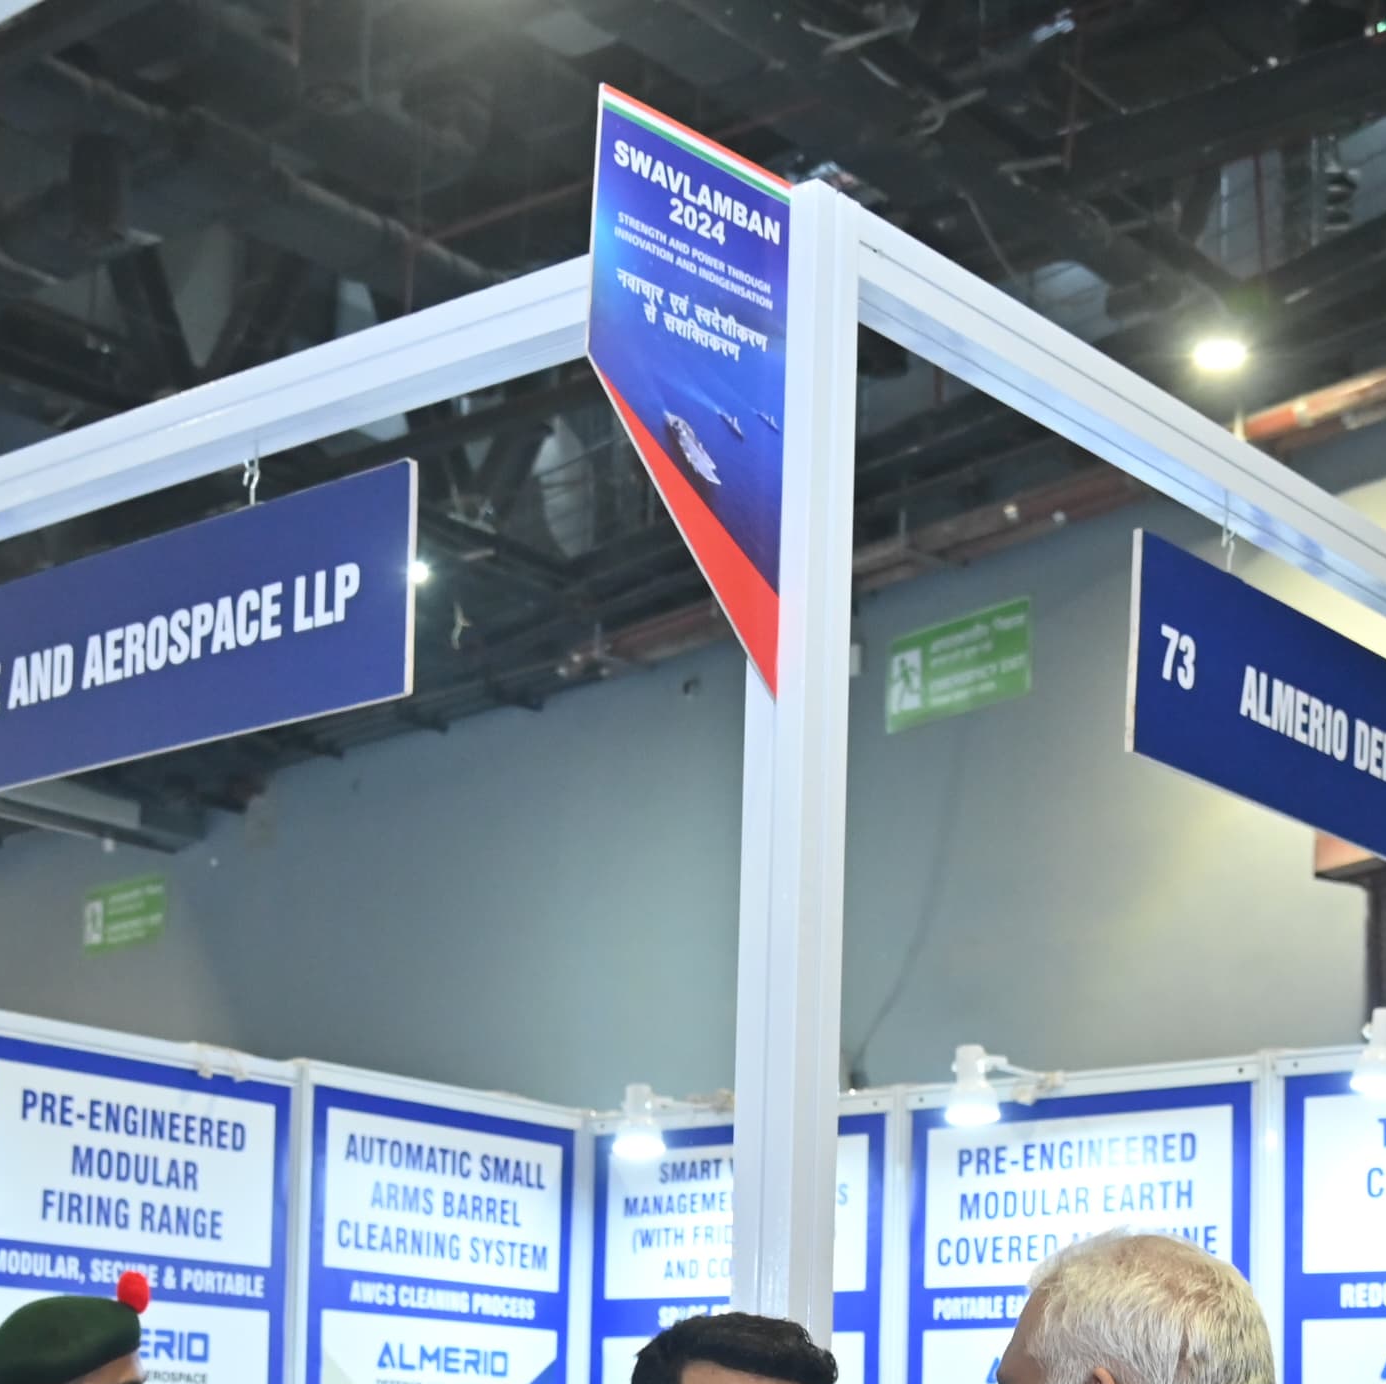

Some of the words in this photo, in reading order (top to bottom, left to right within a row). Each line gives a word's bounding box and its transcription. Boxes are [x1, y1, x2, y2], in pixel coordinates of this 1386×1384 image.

[614, 140, 781, 244] SWAVLAMBAN
[669, 198, 725, 245] 2024
[615, 226, 674, 263] INNOVATION
[676, 256, 697, 274] AND
[699, 268, 773, 310] INDIGENISATION
[618, 212, 667, 244] STRENGTH
[669, 237, 690, 255] AND
[692, 247, 725, 274] POWER
[727, 264, 771, 294] THROUGH
[8, 643, 73, 708] AND
[82, 582, 282, 688] AEROSPACE
[293, 562, 361, 632] LLP
[1161, 624, 1196, 690] 73
[1239, 665, 1347, 762] ALMERIO
[22, 1088, 246, 1151] PRE-ENGINEERED
[71, 1145, 198, 1191] MODULAR
[345, 1133, 472, 1180] AUTOMATIC
[481, 1154, 545, 1190] SMALL
[659, 1158, 721, 1184] SMART
[958, 1132, 1197, 1178] PRE-ENGINEERED
[42, 1189, 129, 1230] FIRING
[141, 1202, 223, 1240] RANGE
[371, 1180, 434, 1216] ARMS
[443, 1191, 521, 1227] BARREL
[623, 1192, 733, 1218] MANAGEME
[960, 1186, 1089, 1221] MODULAR
[1103, 1180, 1193, 1212] EARTH
[337, 1220, 460, 1261] CLEARNING
[469, 1236, 547, 1272] SYSTEM
[633, 1228, 684, 1254] (WITH
[937, 1234, 1058, 1267] COVERED
[163, 1265, 176, 1290] &
[181, 1268, 265, 1298] PORTABLE
[664, 1259, 699, 1280] AND
[350, 1280, 395, 1306] AWCS
[398, 1284, 469, 1314] CLEANING
[472, 1293, 535, 1320] PROCESS
[933, 1296, 1003, 1320] PORTABLE
[377, 1342, 508, 1377] ALMERIO
